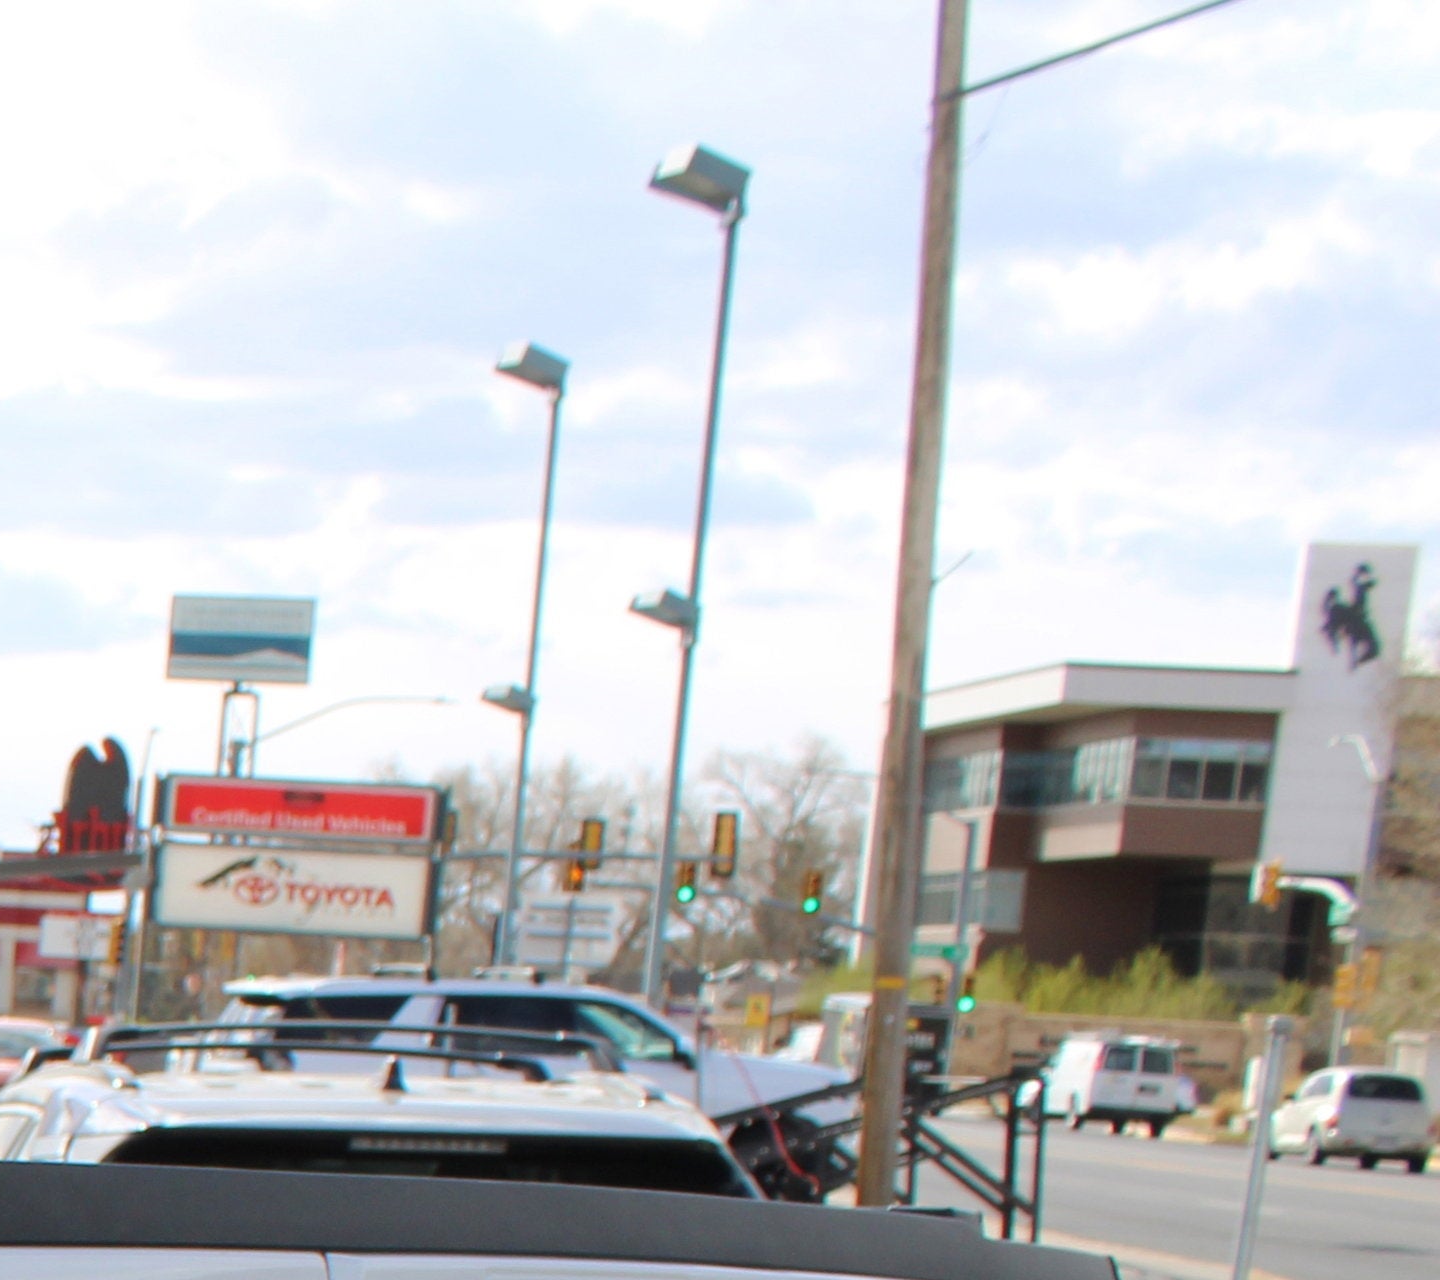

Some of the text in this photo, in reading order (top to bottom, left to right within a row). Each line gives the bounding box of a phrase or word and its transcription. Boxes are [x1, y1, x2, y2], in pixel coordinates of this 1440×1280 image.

[191, 806, 407, 834] Certified Used Vehicles
[284, 880, 395, 908] TOYOTA
